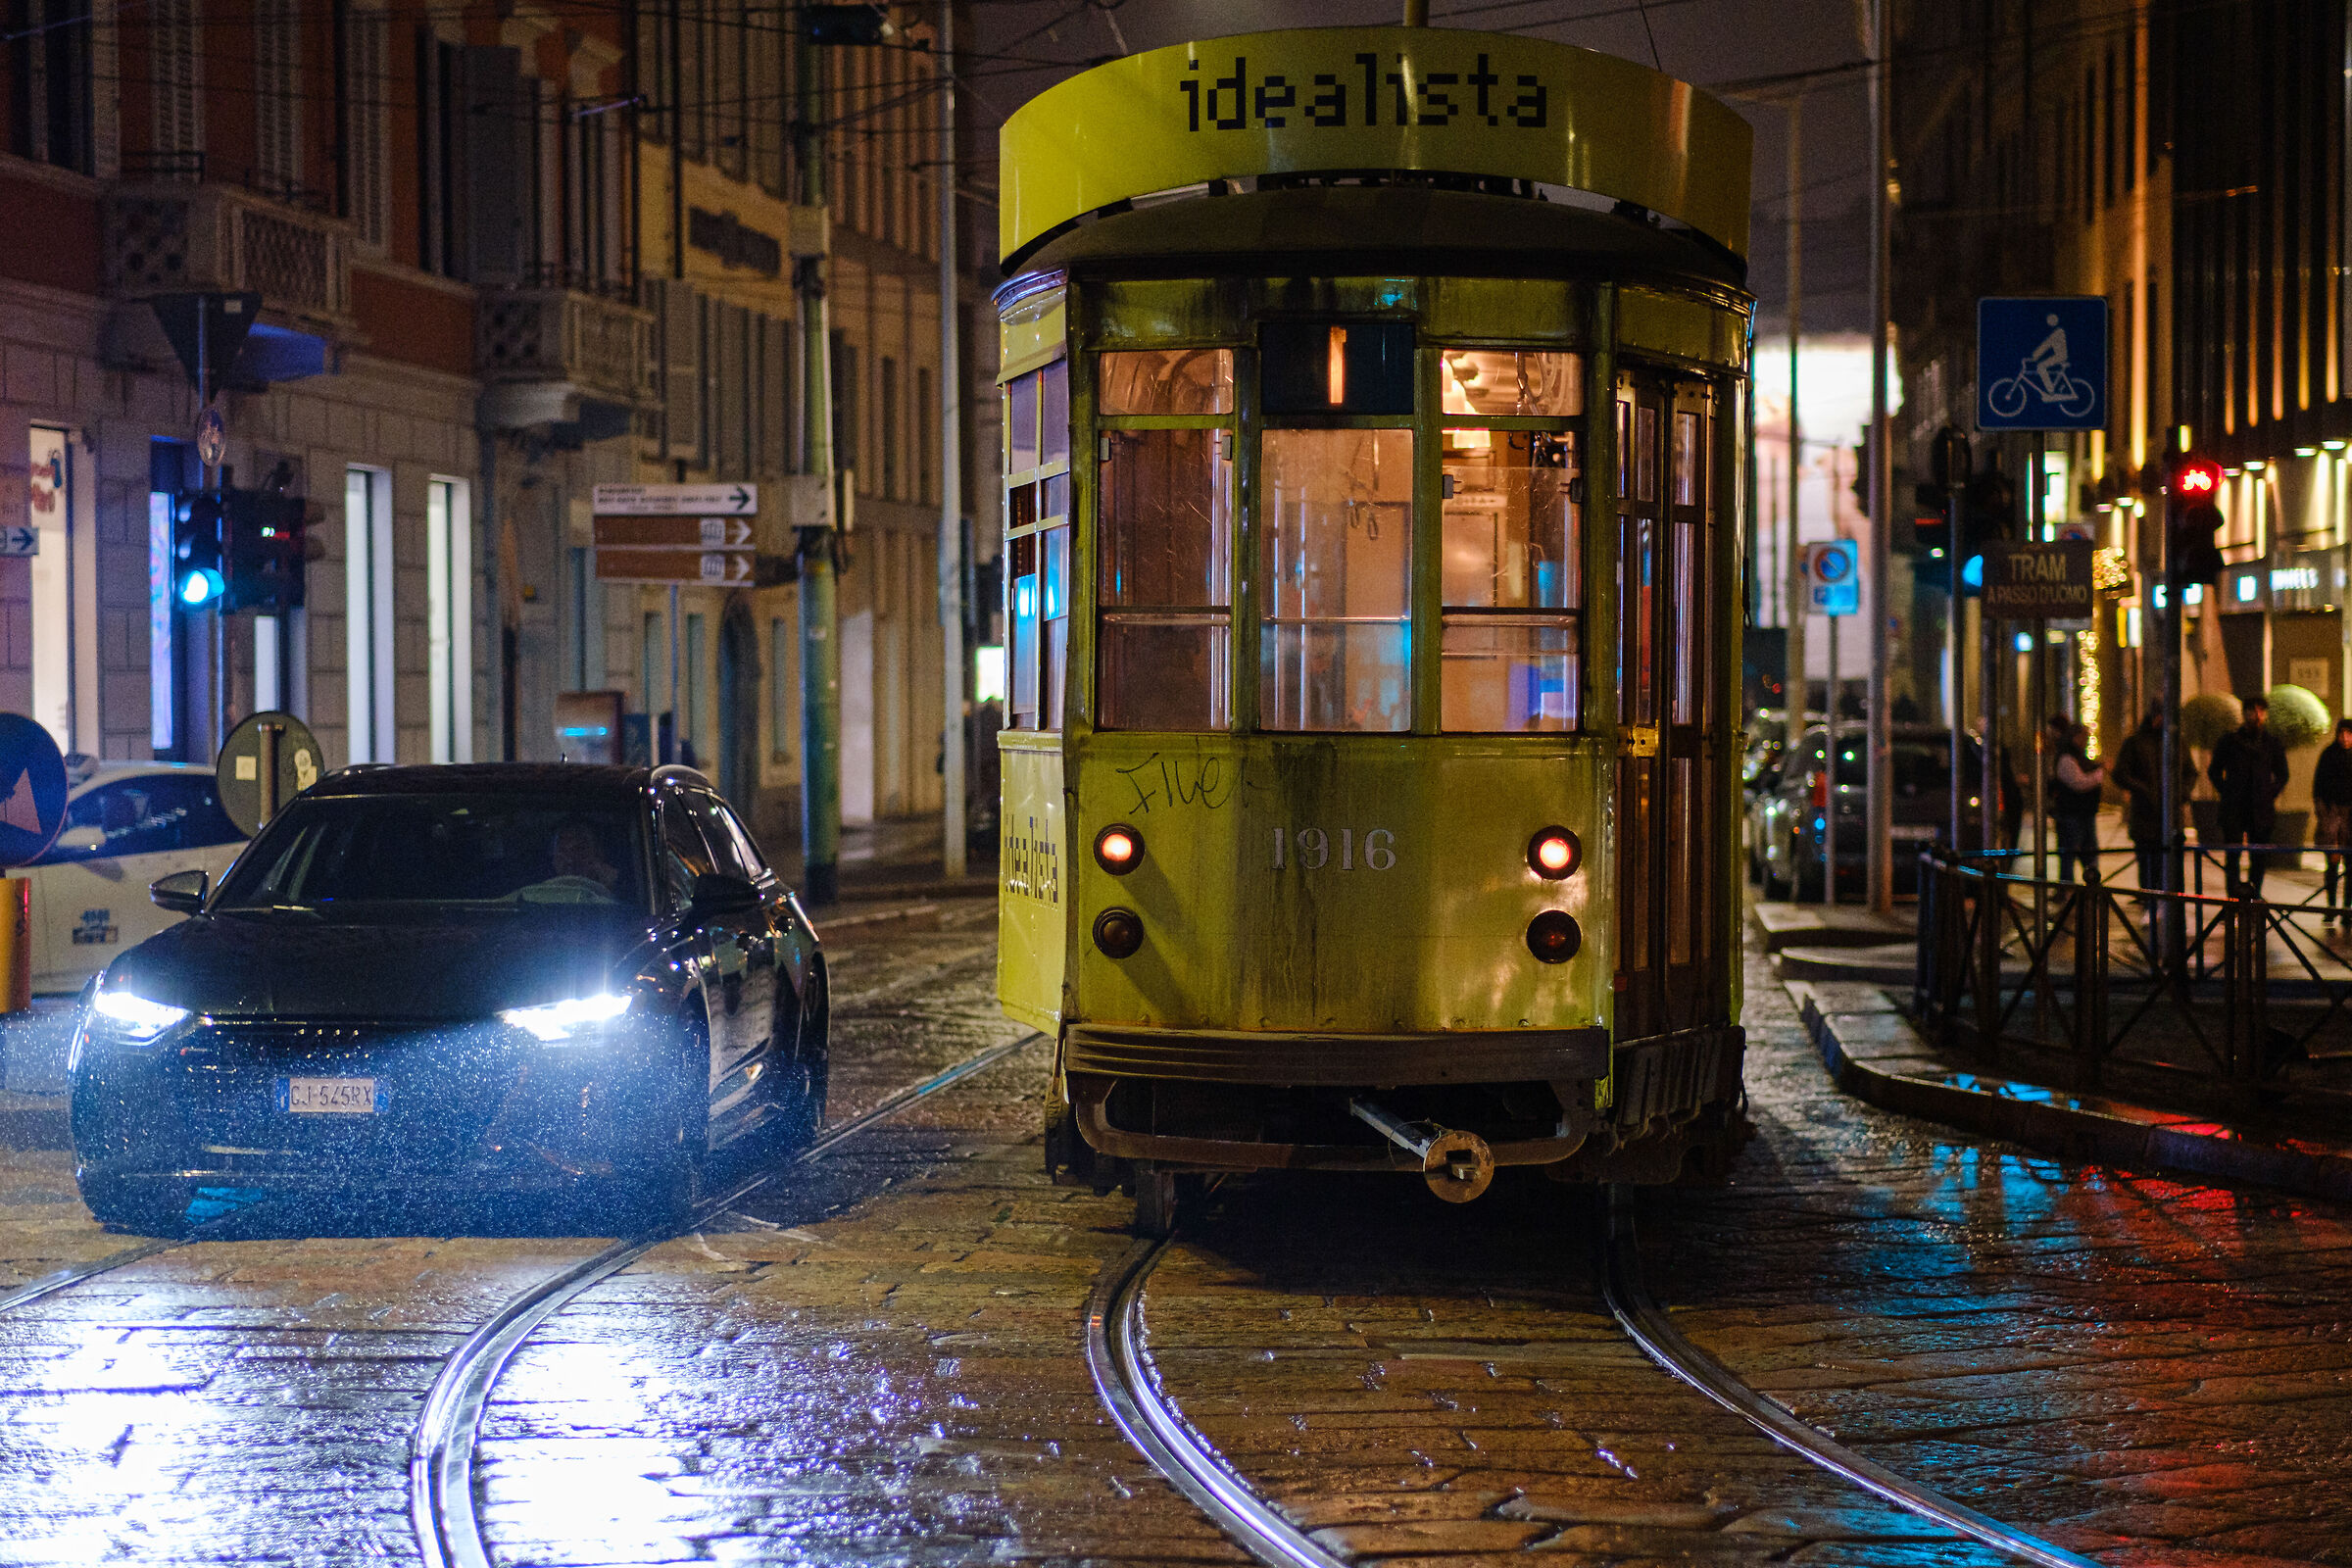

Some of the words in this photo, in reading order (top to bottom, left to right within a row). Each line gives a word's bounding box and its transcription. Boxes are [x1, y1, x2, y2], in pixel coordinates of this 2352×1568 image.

[1180, 53, 1546, 131] idealista
[2008, 553, 2066, 581] TRAM
[1271, 827, 1397, 871] 1916
